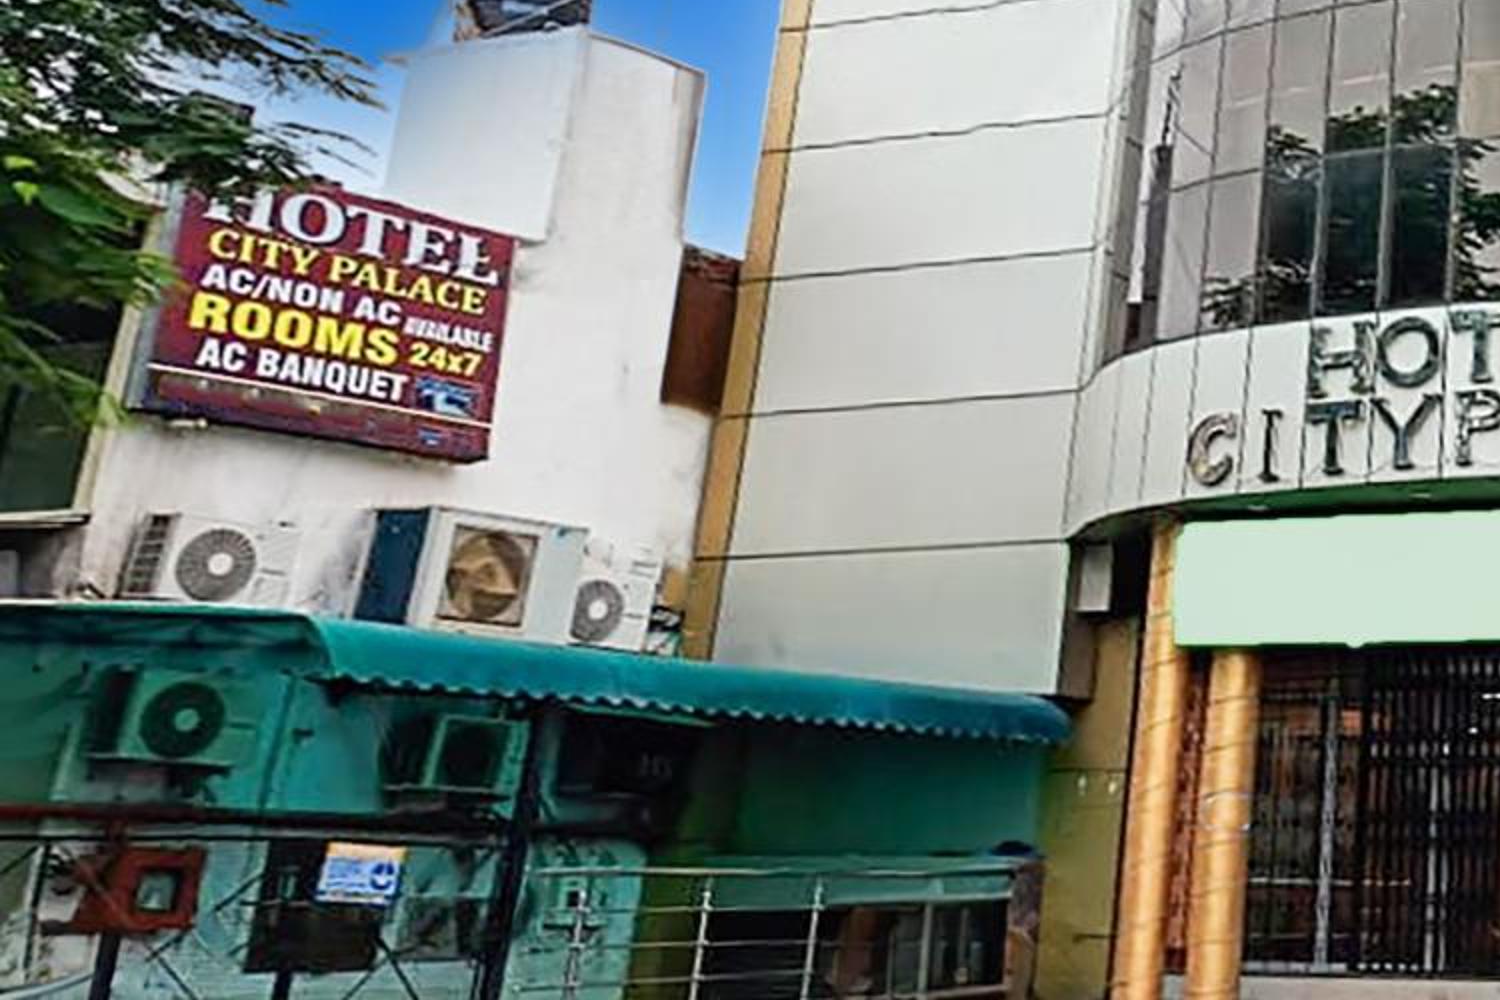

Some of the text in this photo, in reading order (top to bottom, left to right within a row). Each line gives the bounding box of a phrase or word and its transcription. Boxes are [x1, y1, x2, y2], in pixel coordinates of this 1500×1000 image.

[200, 263, 402, 327] AC/NON AC
[208, 228, 488, 315] CITY PALACE
[188, 290, 401, 367] ROOMS
[195, 337, 410, 402] AC BANQUET
